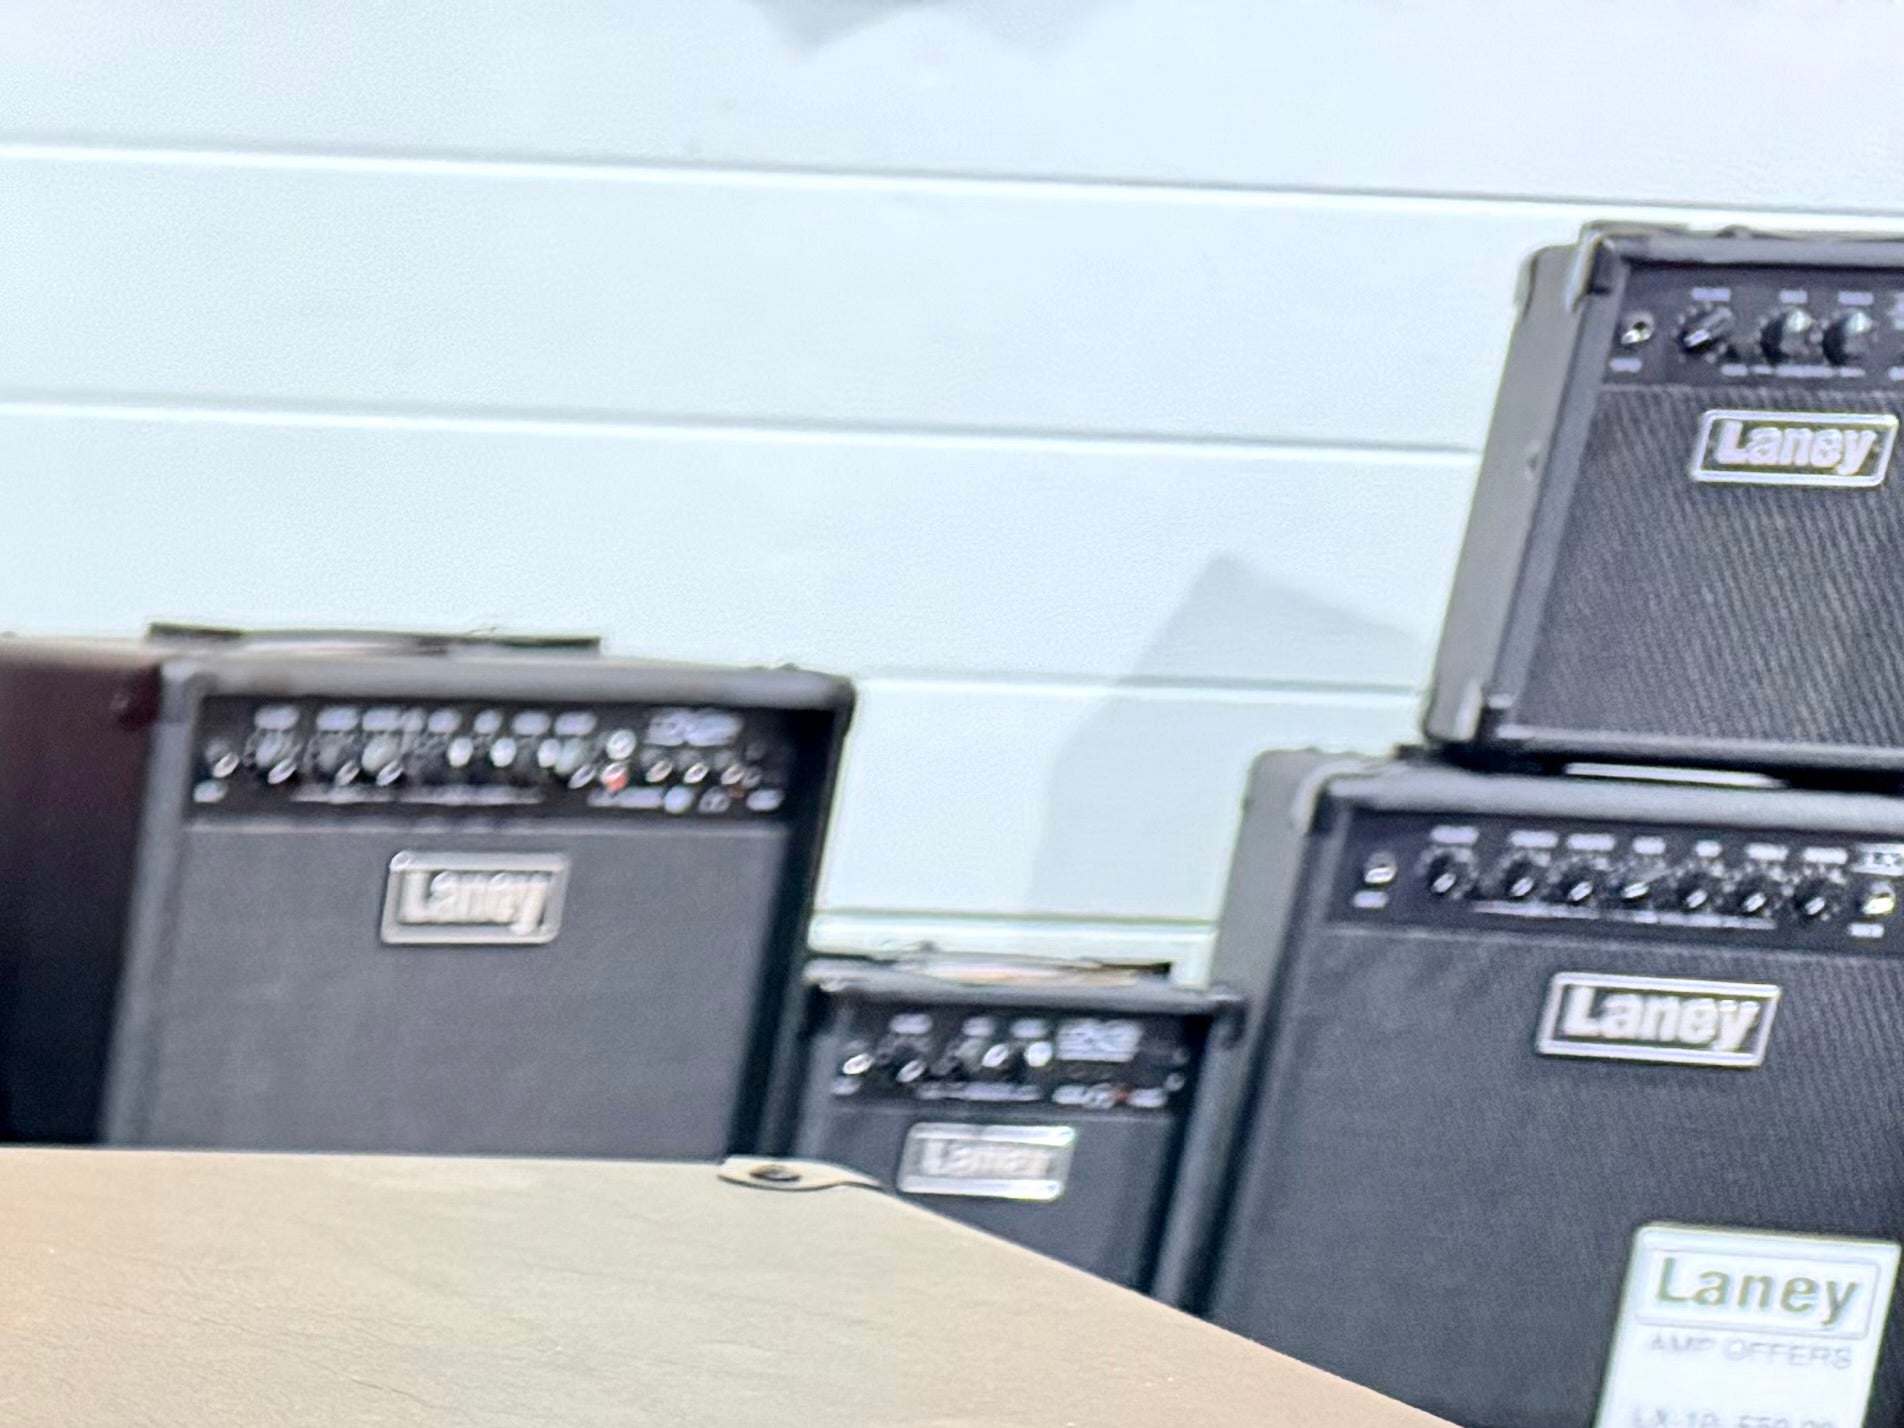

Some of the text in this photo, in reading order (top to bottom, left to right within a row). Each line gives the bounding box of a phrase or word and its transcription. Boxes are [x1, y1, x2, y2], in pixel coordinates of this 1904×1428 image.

[1716, 420, 1876, 476] Laney
[398, 870, 548, 935] Laney
[1563, 986, 1760, 1052] Laney
[1657, 1257, 1860, 1326] Laney
[1724, 1339, 1852, 1370] OFFERS
